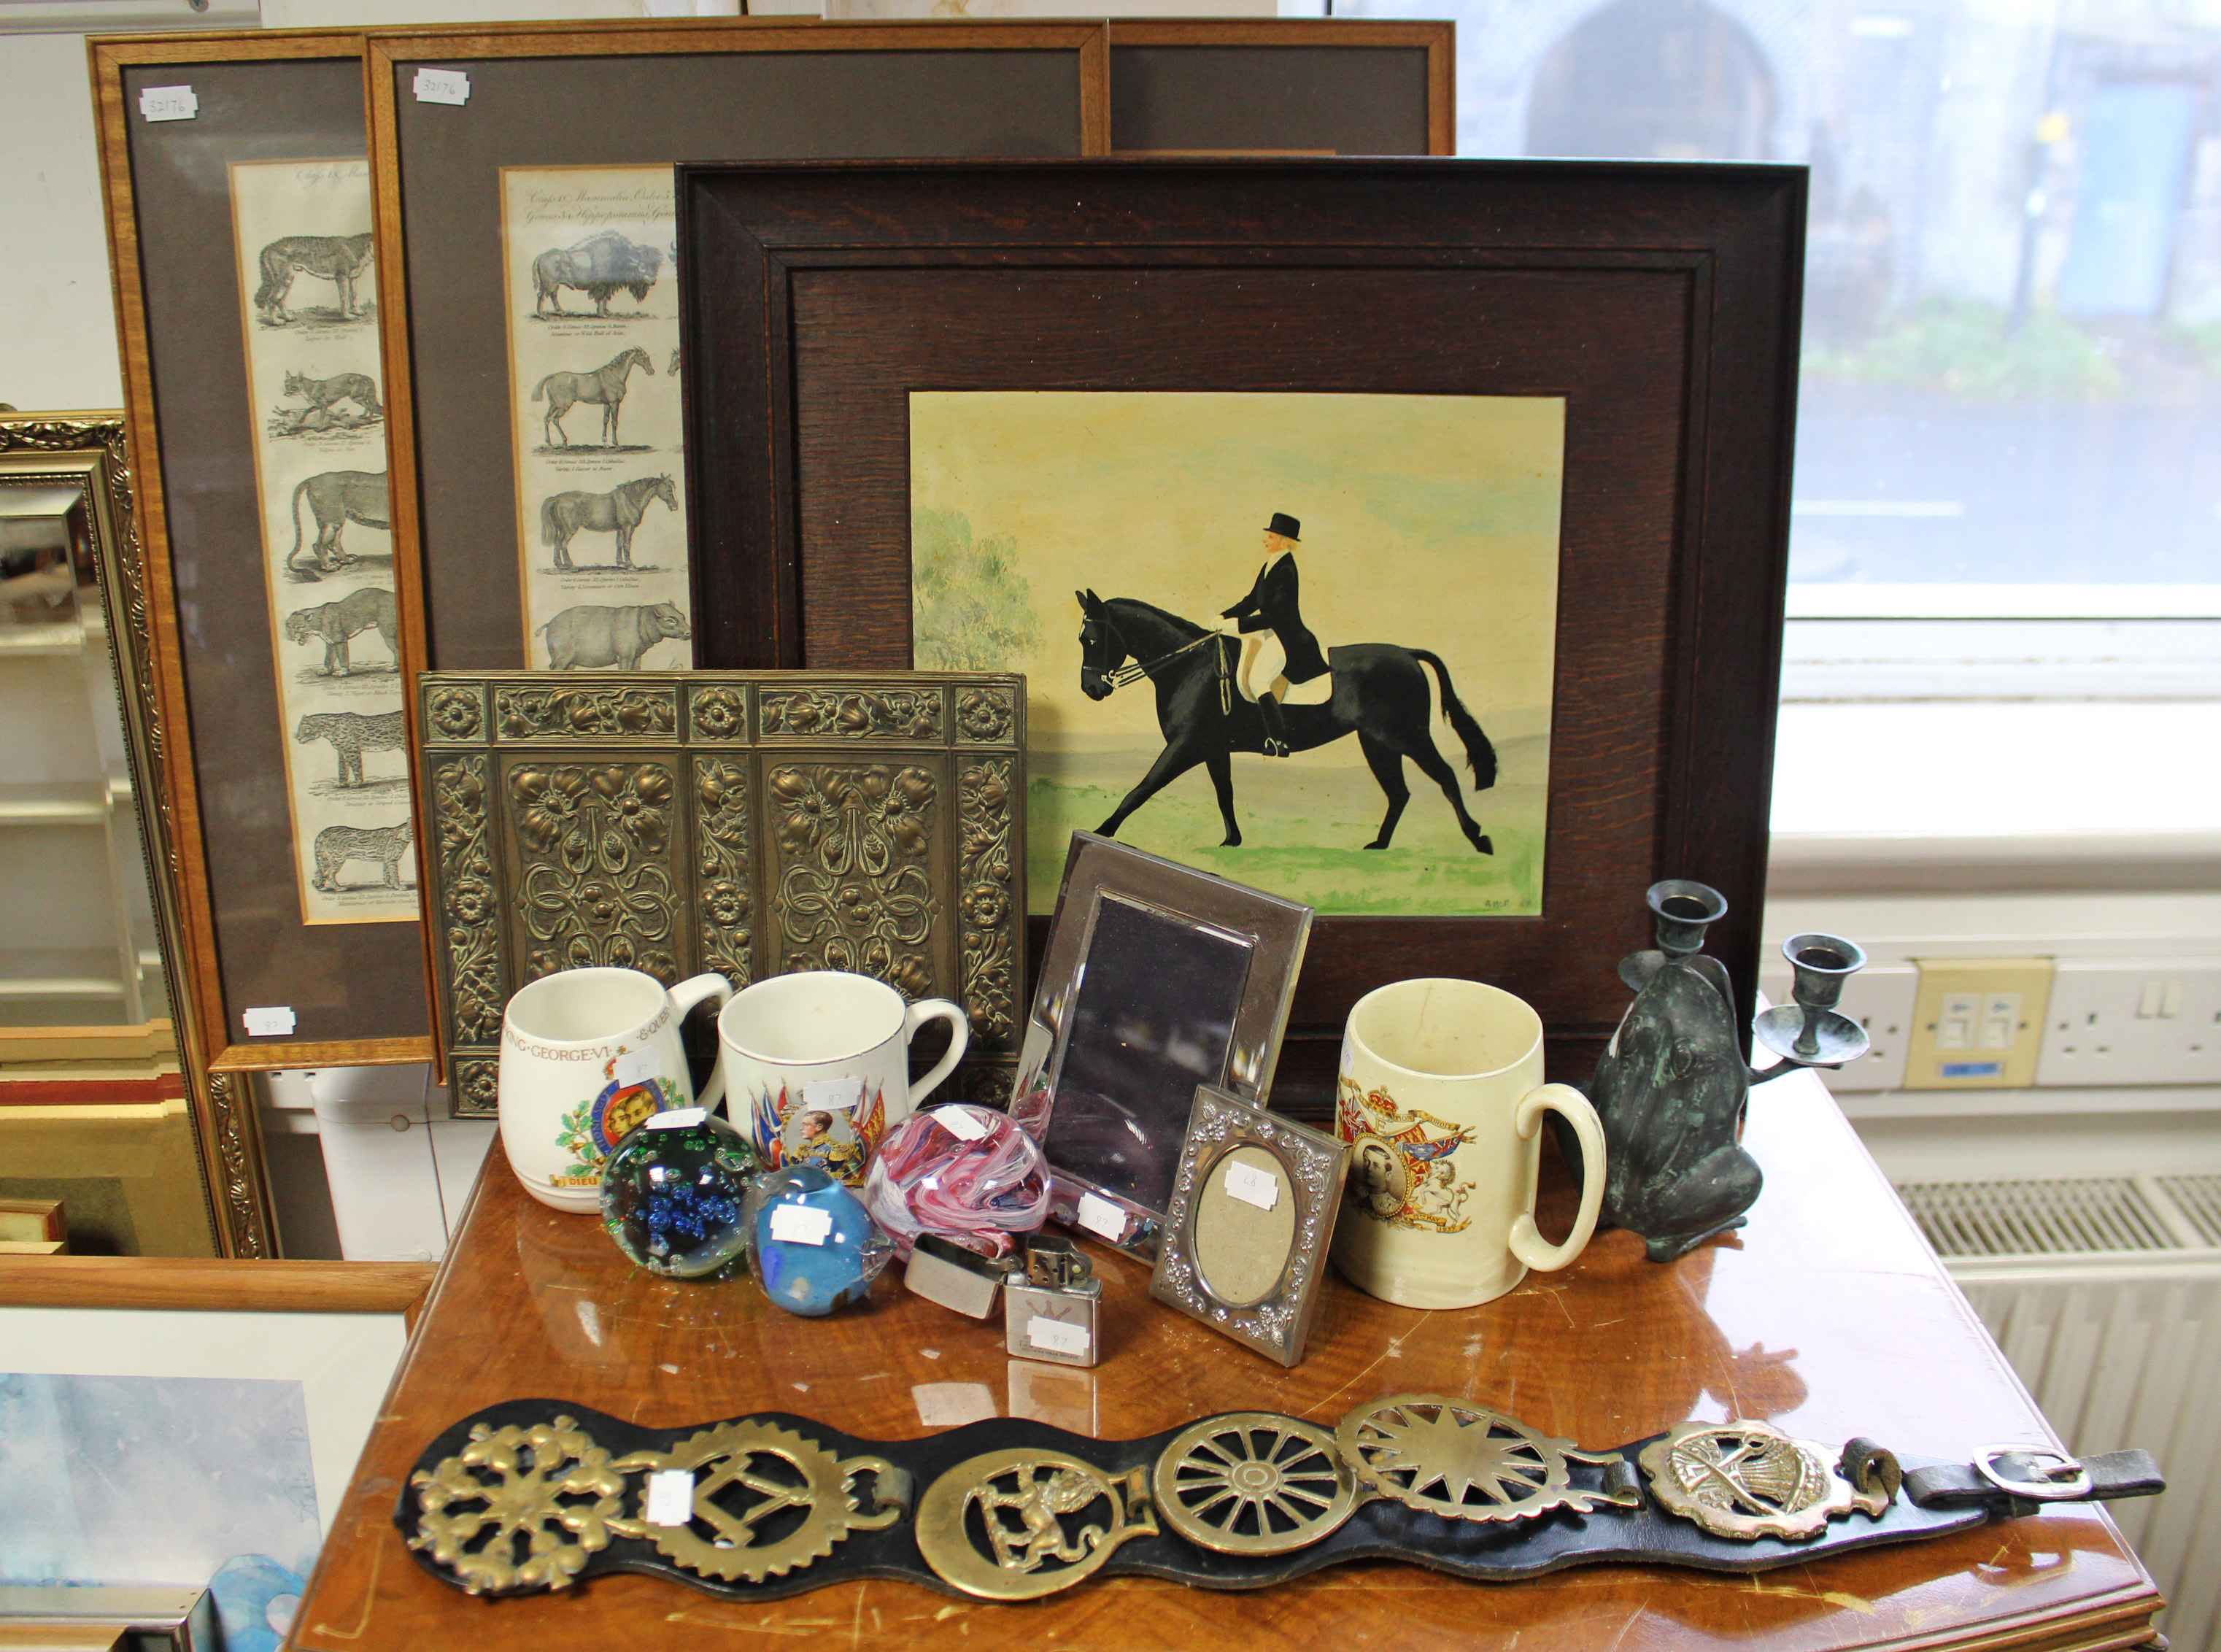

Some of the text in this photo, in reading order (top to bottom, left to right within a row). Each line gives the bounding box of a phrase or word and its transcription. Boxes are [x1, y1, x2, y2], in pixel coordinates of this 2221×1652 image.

[530, 1044, 592, 1062] GEORGE
[1430, 1119, 1452, 1130] DROIT
[568, 1178, 598, 1186] DIEU
[1053, 1335, 1068, 1347] 87
